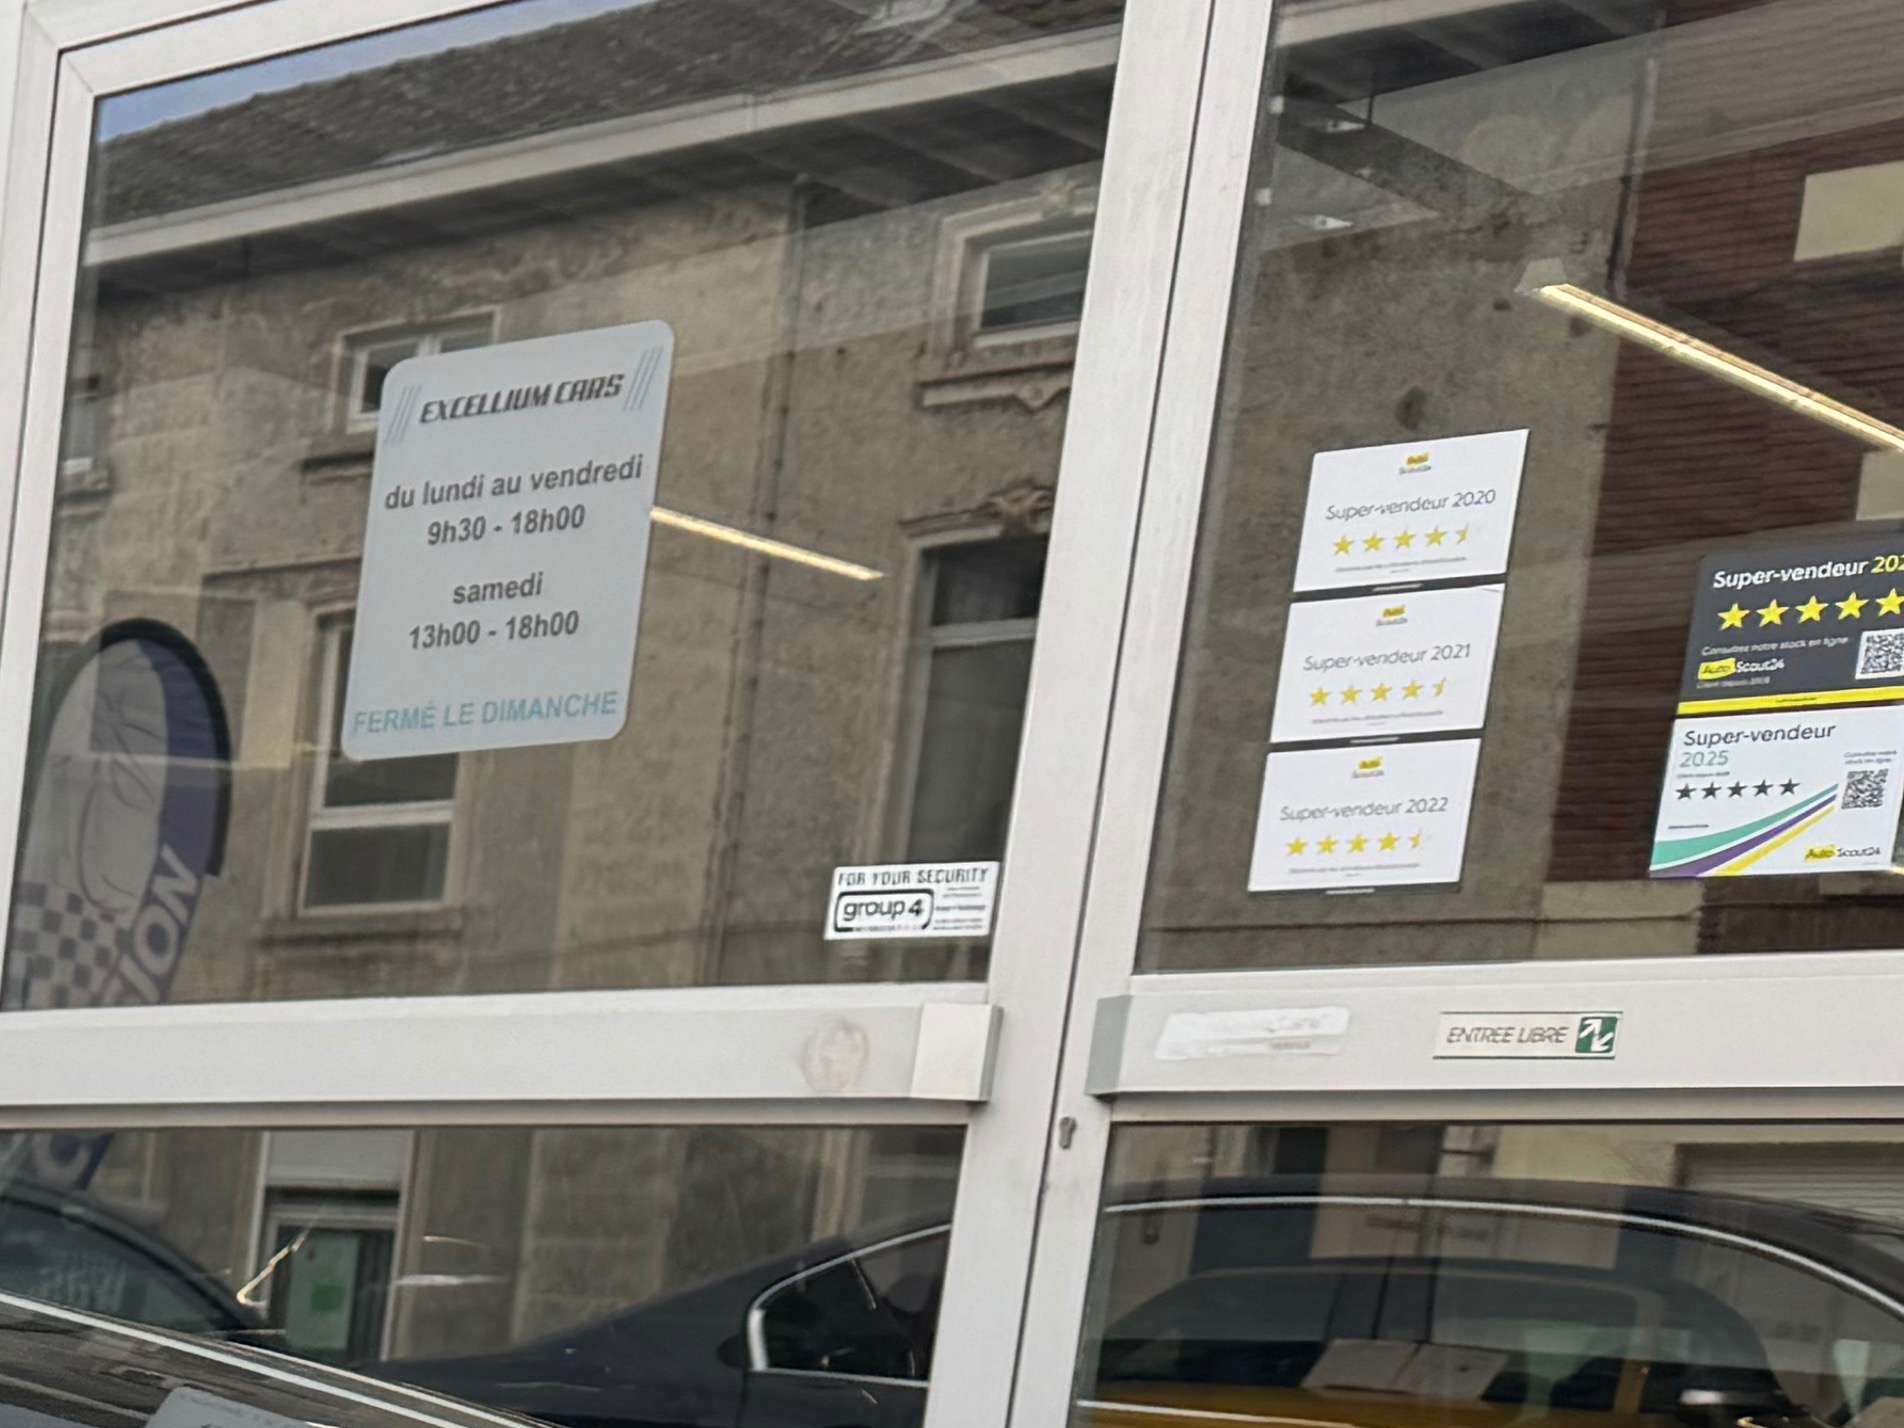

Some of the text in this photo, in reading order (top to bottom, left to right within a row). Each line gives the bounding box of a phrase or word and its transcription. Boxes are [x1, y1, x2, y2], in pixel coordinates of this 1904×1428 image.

[420, 372, 626, 424] EXCELLIUM CARS
[384, 454, 644, 510] du lundi au vendredi
[1325, 489, 1497, 522] Super-vendeur 2020
[427, 516, 487, 546] 9h30
[511, 504, 587, 536] 18h00
[452, 571, 544, 605] samedi
[1713, 560, 1869, 590] Super-vendeur
[408, 619, 481, 650] 13h00
[505, 610, 580, 641] 18h00
[1302, 643, 1471, 674] Super-vendeur 2021
[442, 702, 474, 728] LE
[481, 691, 619, 726] DIMANCHE
[1683, 724, 1836, 748] Super-vendeur
[1679, 750, 1730, 768] 2025
[1280, 796, 1449, 823] Super-vendeur 2022
[838, 867, 989, 887] FOR YOUR SECURITY
[1446, 1026, 1570, 1044] ENTREE LIBRE
